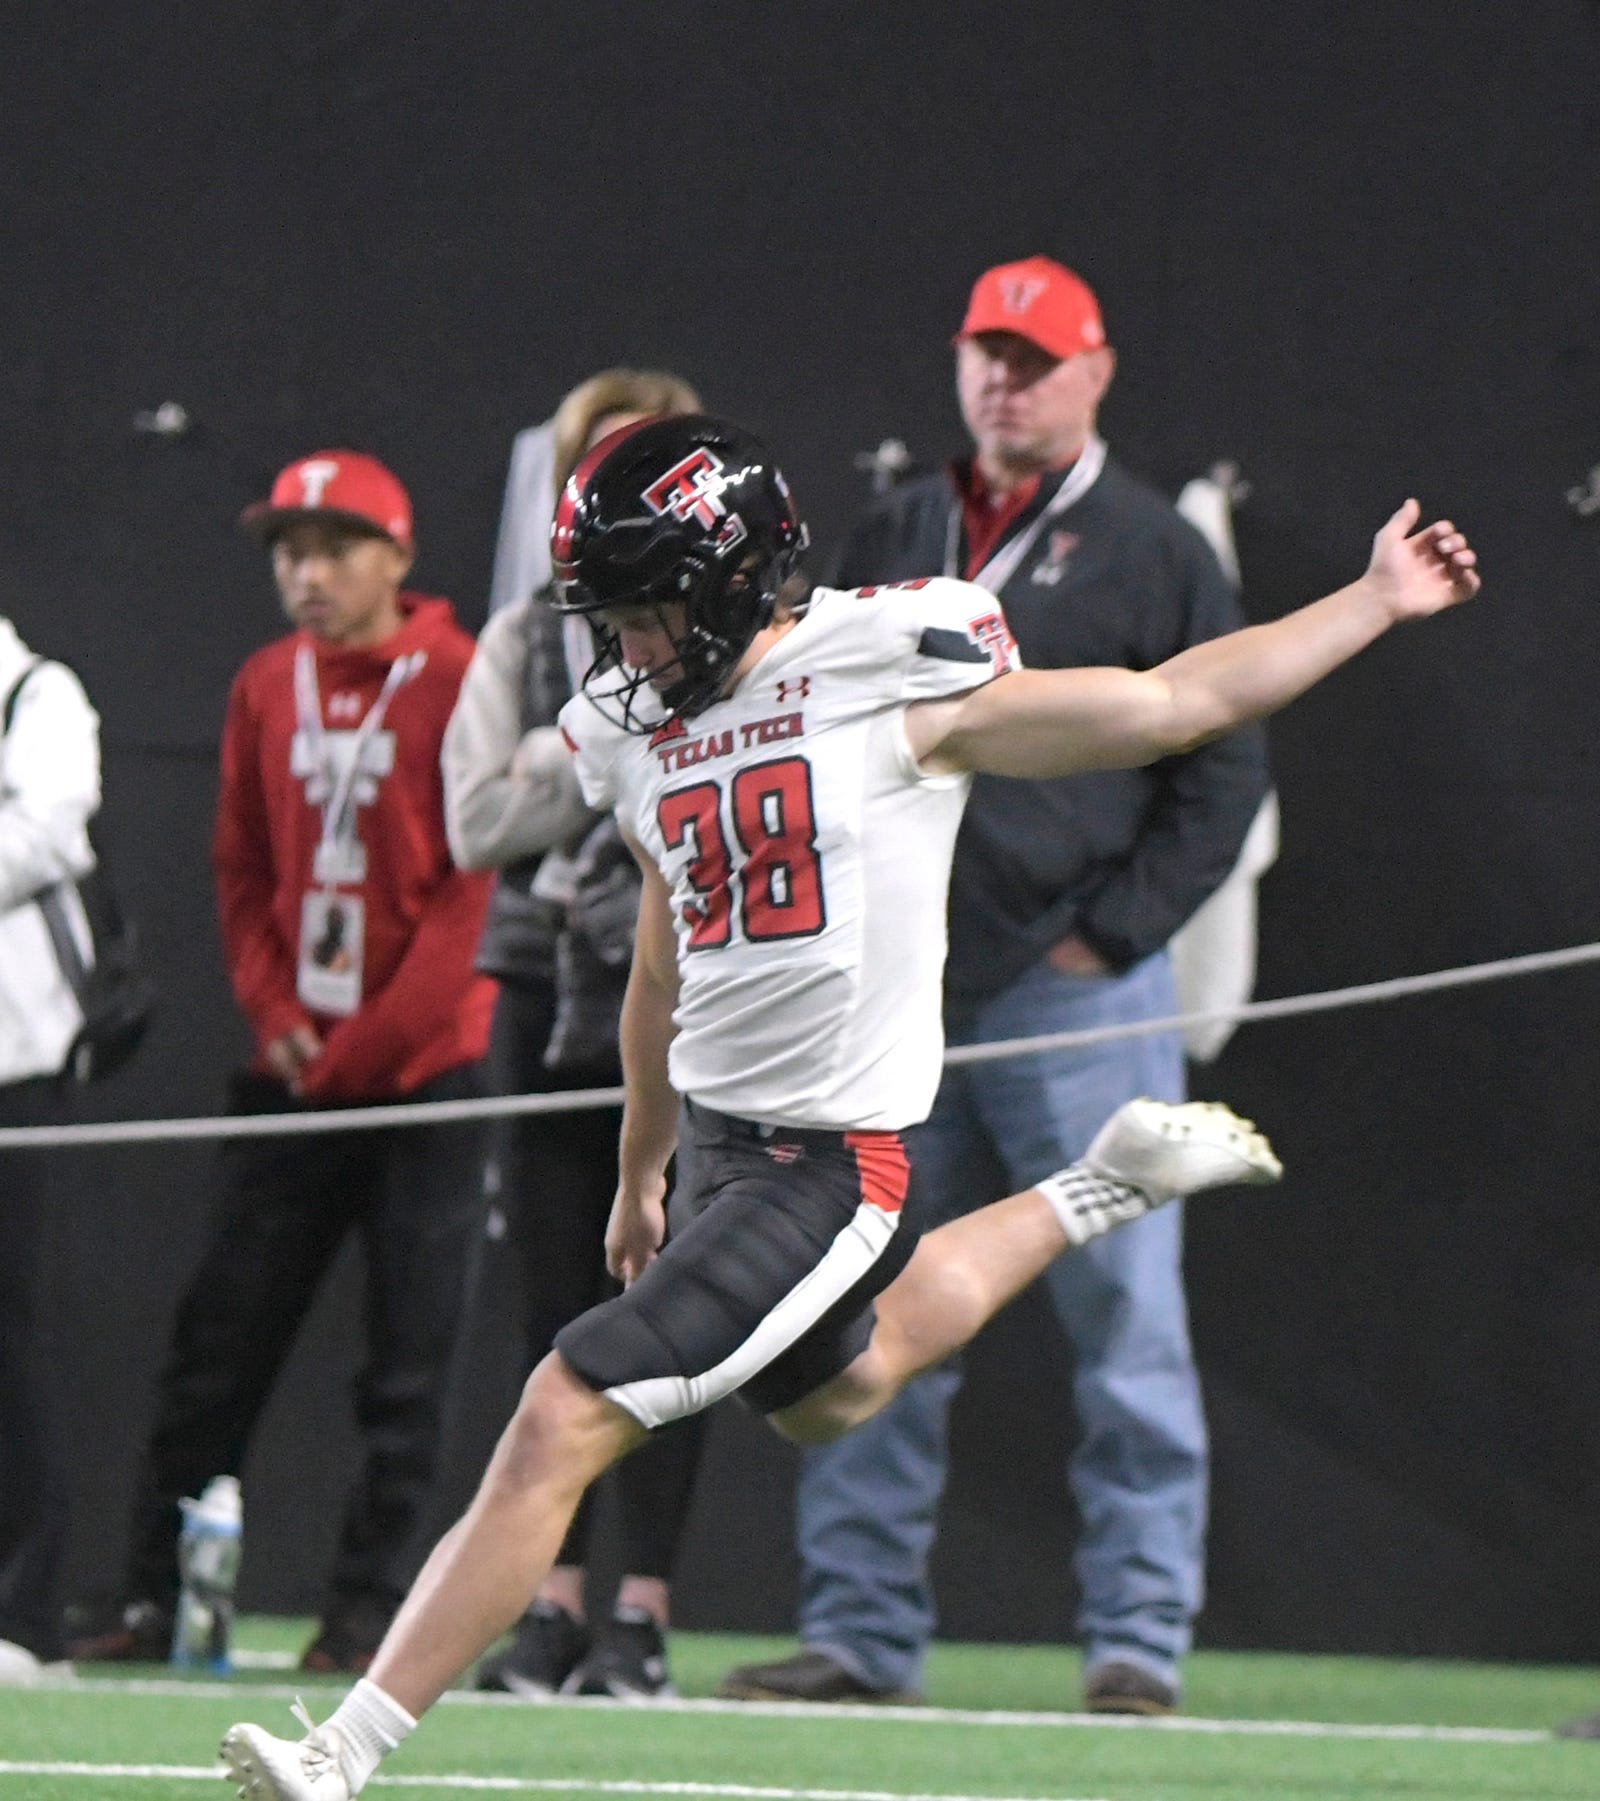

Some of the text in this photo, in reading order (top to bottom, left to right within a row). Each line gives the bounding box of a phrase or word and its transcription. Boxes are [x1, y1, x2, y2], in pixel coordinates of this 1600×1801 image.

[657, 711, 804, 775] TEXAS TECH
[657, 753, 828, 953] 38
